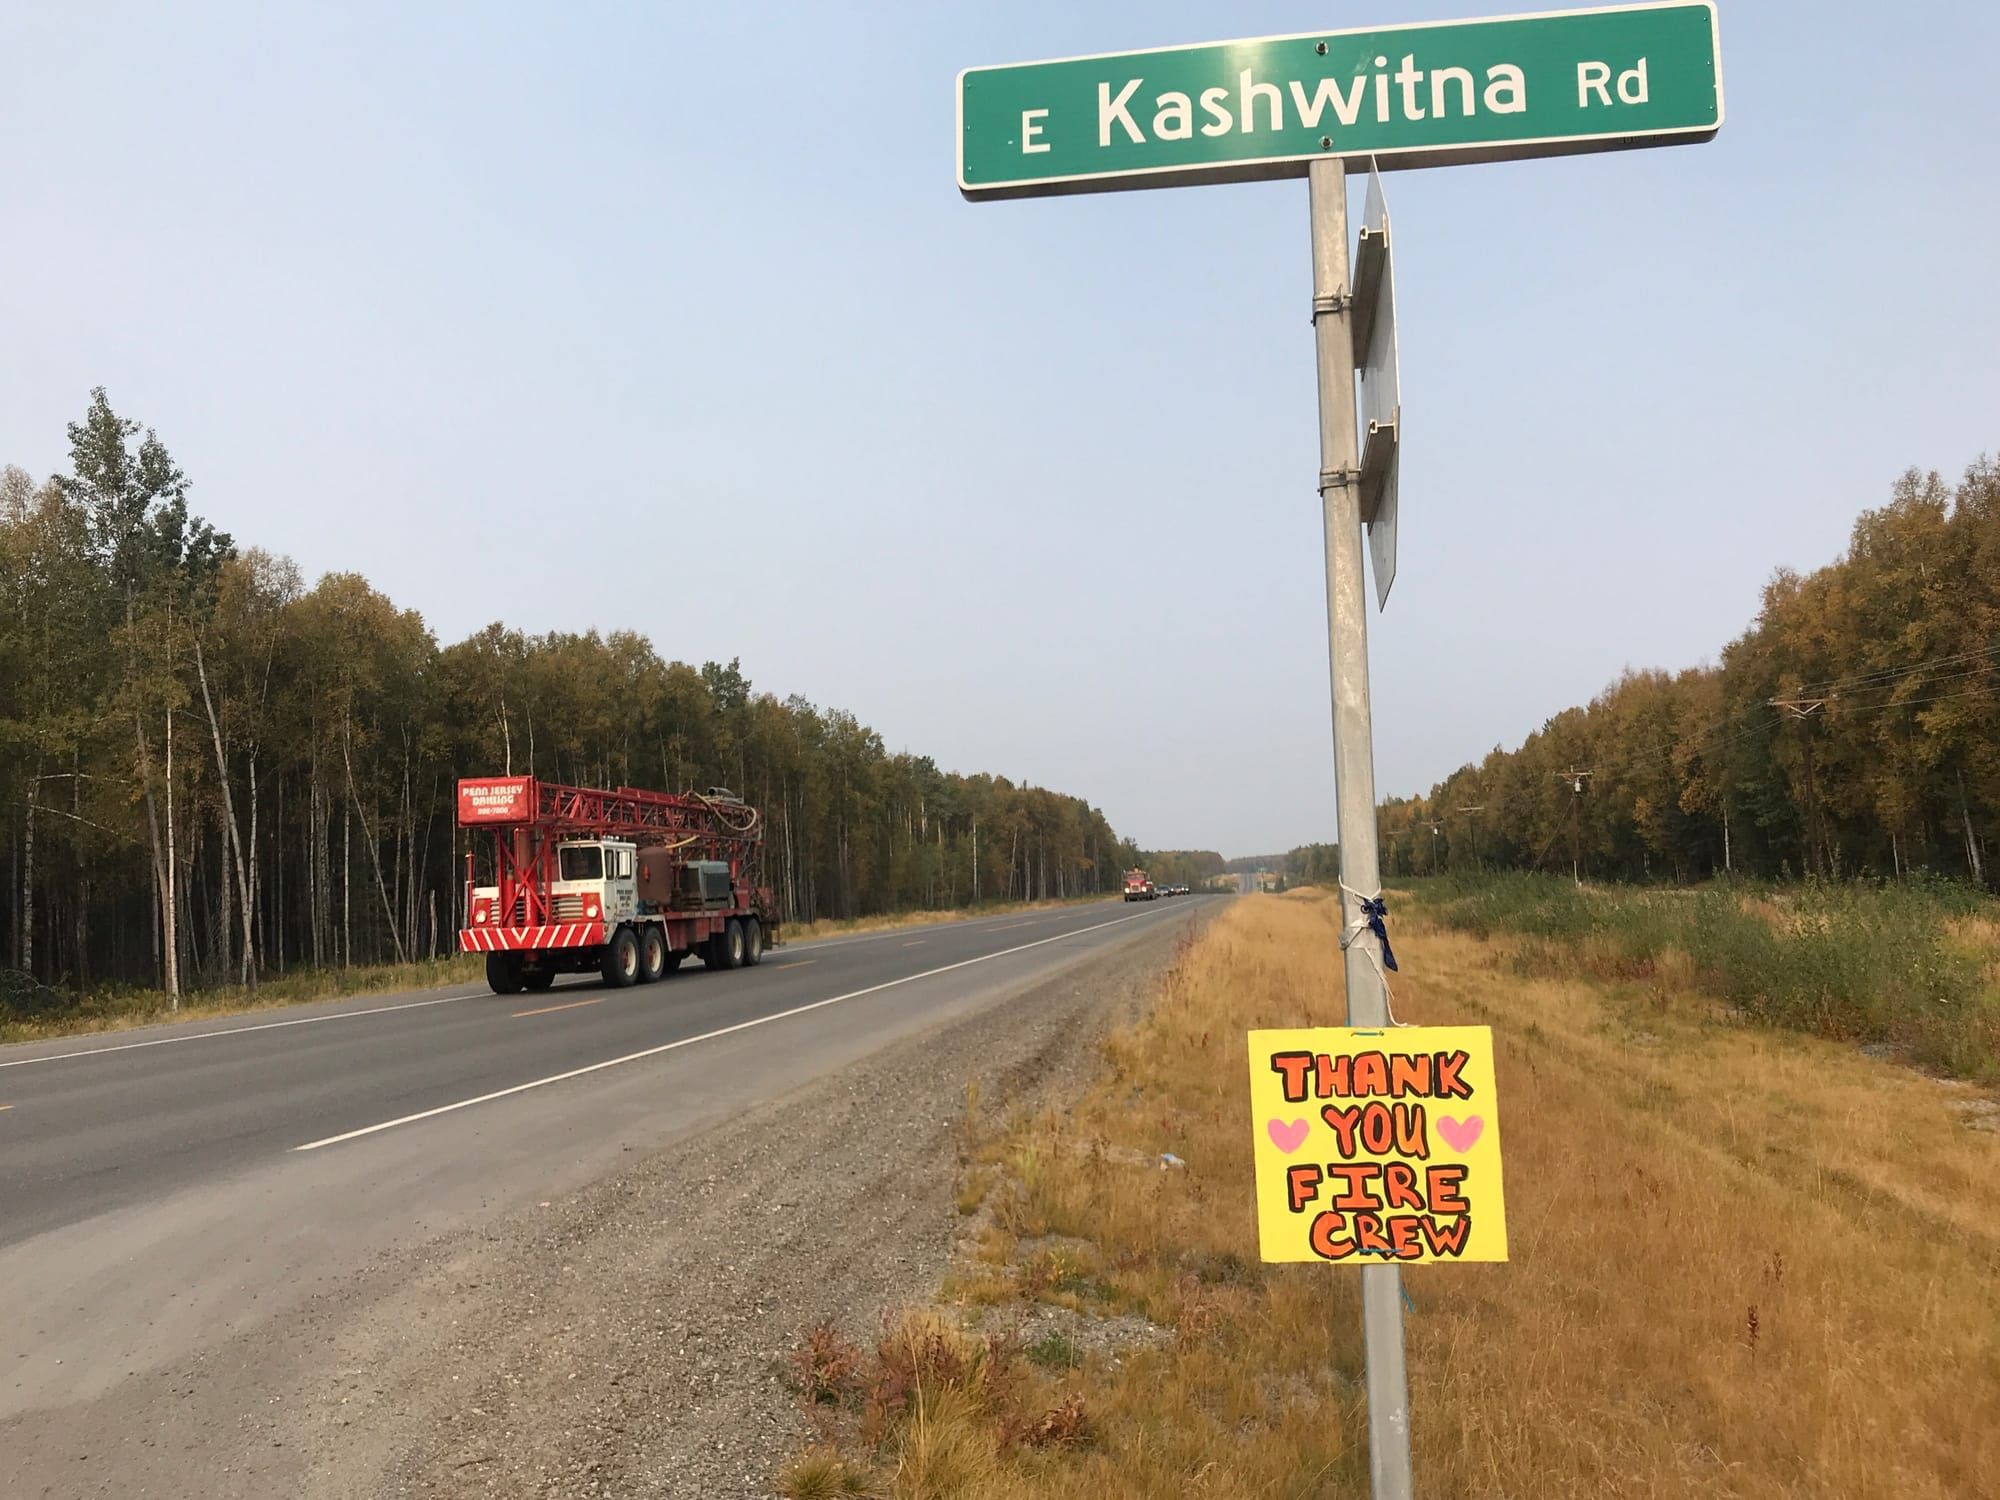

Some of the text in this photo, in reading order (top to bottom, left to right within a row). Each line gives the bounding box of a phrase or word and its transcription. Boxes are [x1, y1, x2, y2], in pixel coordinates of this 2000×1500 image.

[1022, 55, 1648, 153] E Kashwitna Rd
[472, 795, 514, 806] DRILLING
[490, 785, 523, 795] JERSEY
[1271, 1050, 1474, 1102] THANK
[1320, 1100, 1430, 1160] YOU
[1287, 1161, 1471, 1213] FIRE
[1309, 1210, 1471, 1260] CREW
